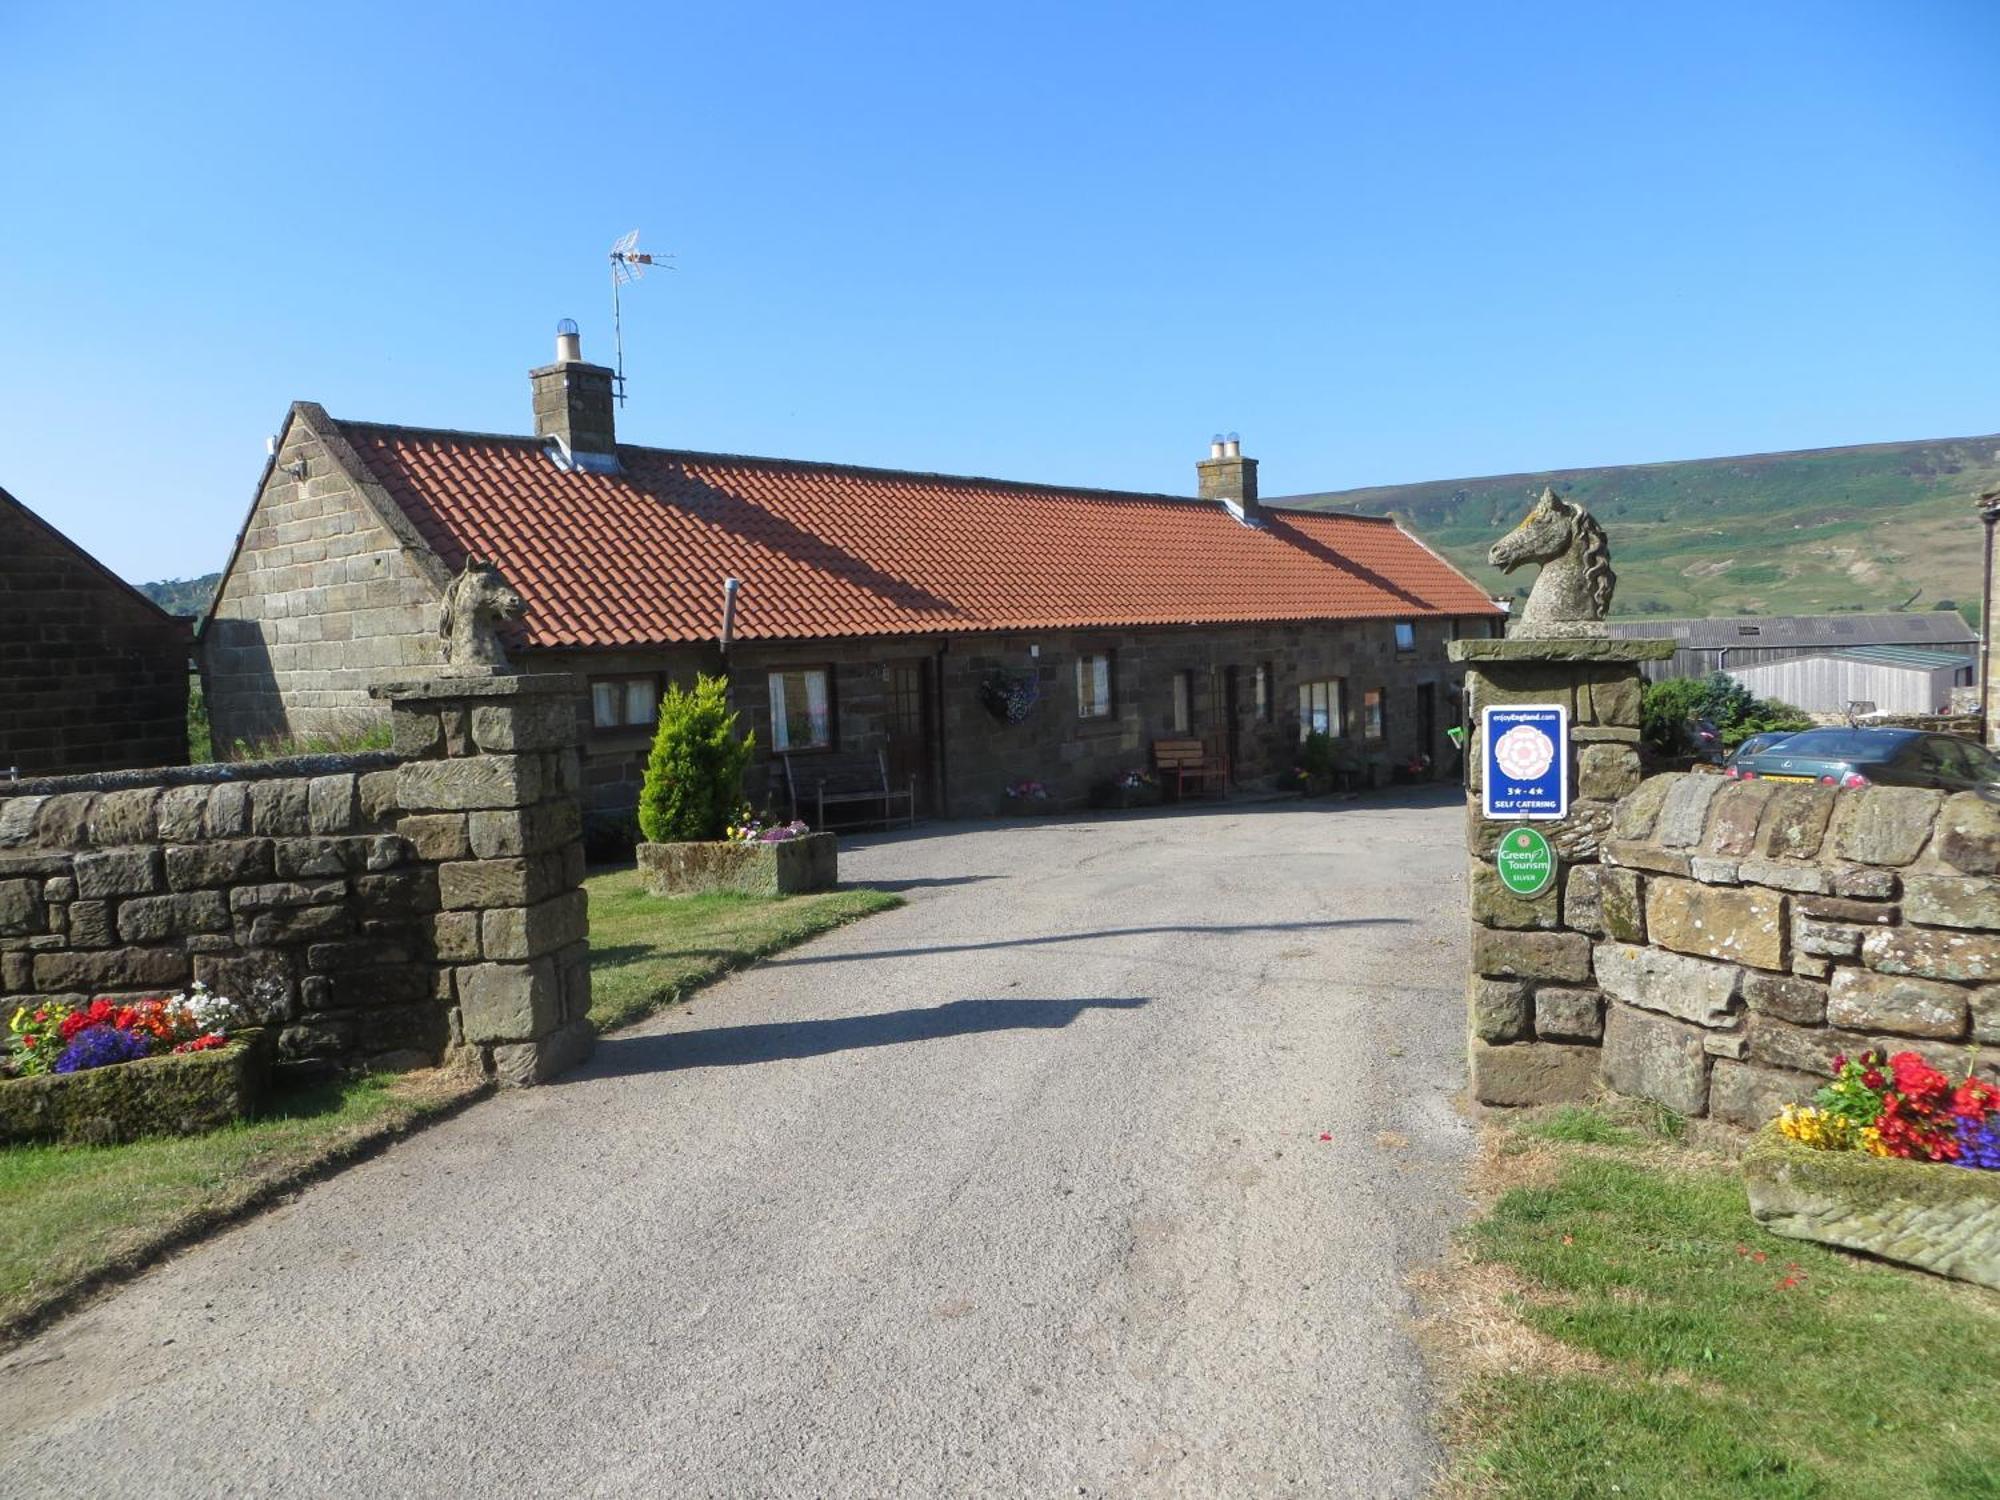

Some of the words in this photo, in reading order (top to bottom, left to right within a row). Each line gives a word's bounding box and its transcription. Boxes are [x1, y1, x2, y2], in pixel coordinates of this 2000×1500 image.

[1494, 800, 1515, 809] SELF
[1515, 800, 1557, 809] CATERING
[1500, 850, 1532, 860] Green
[1507, 860, 1548, 870] Tourism
